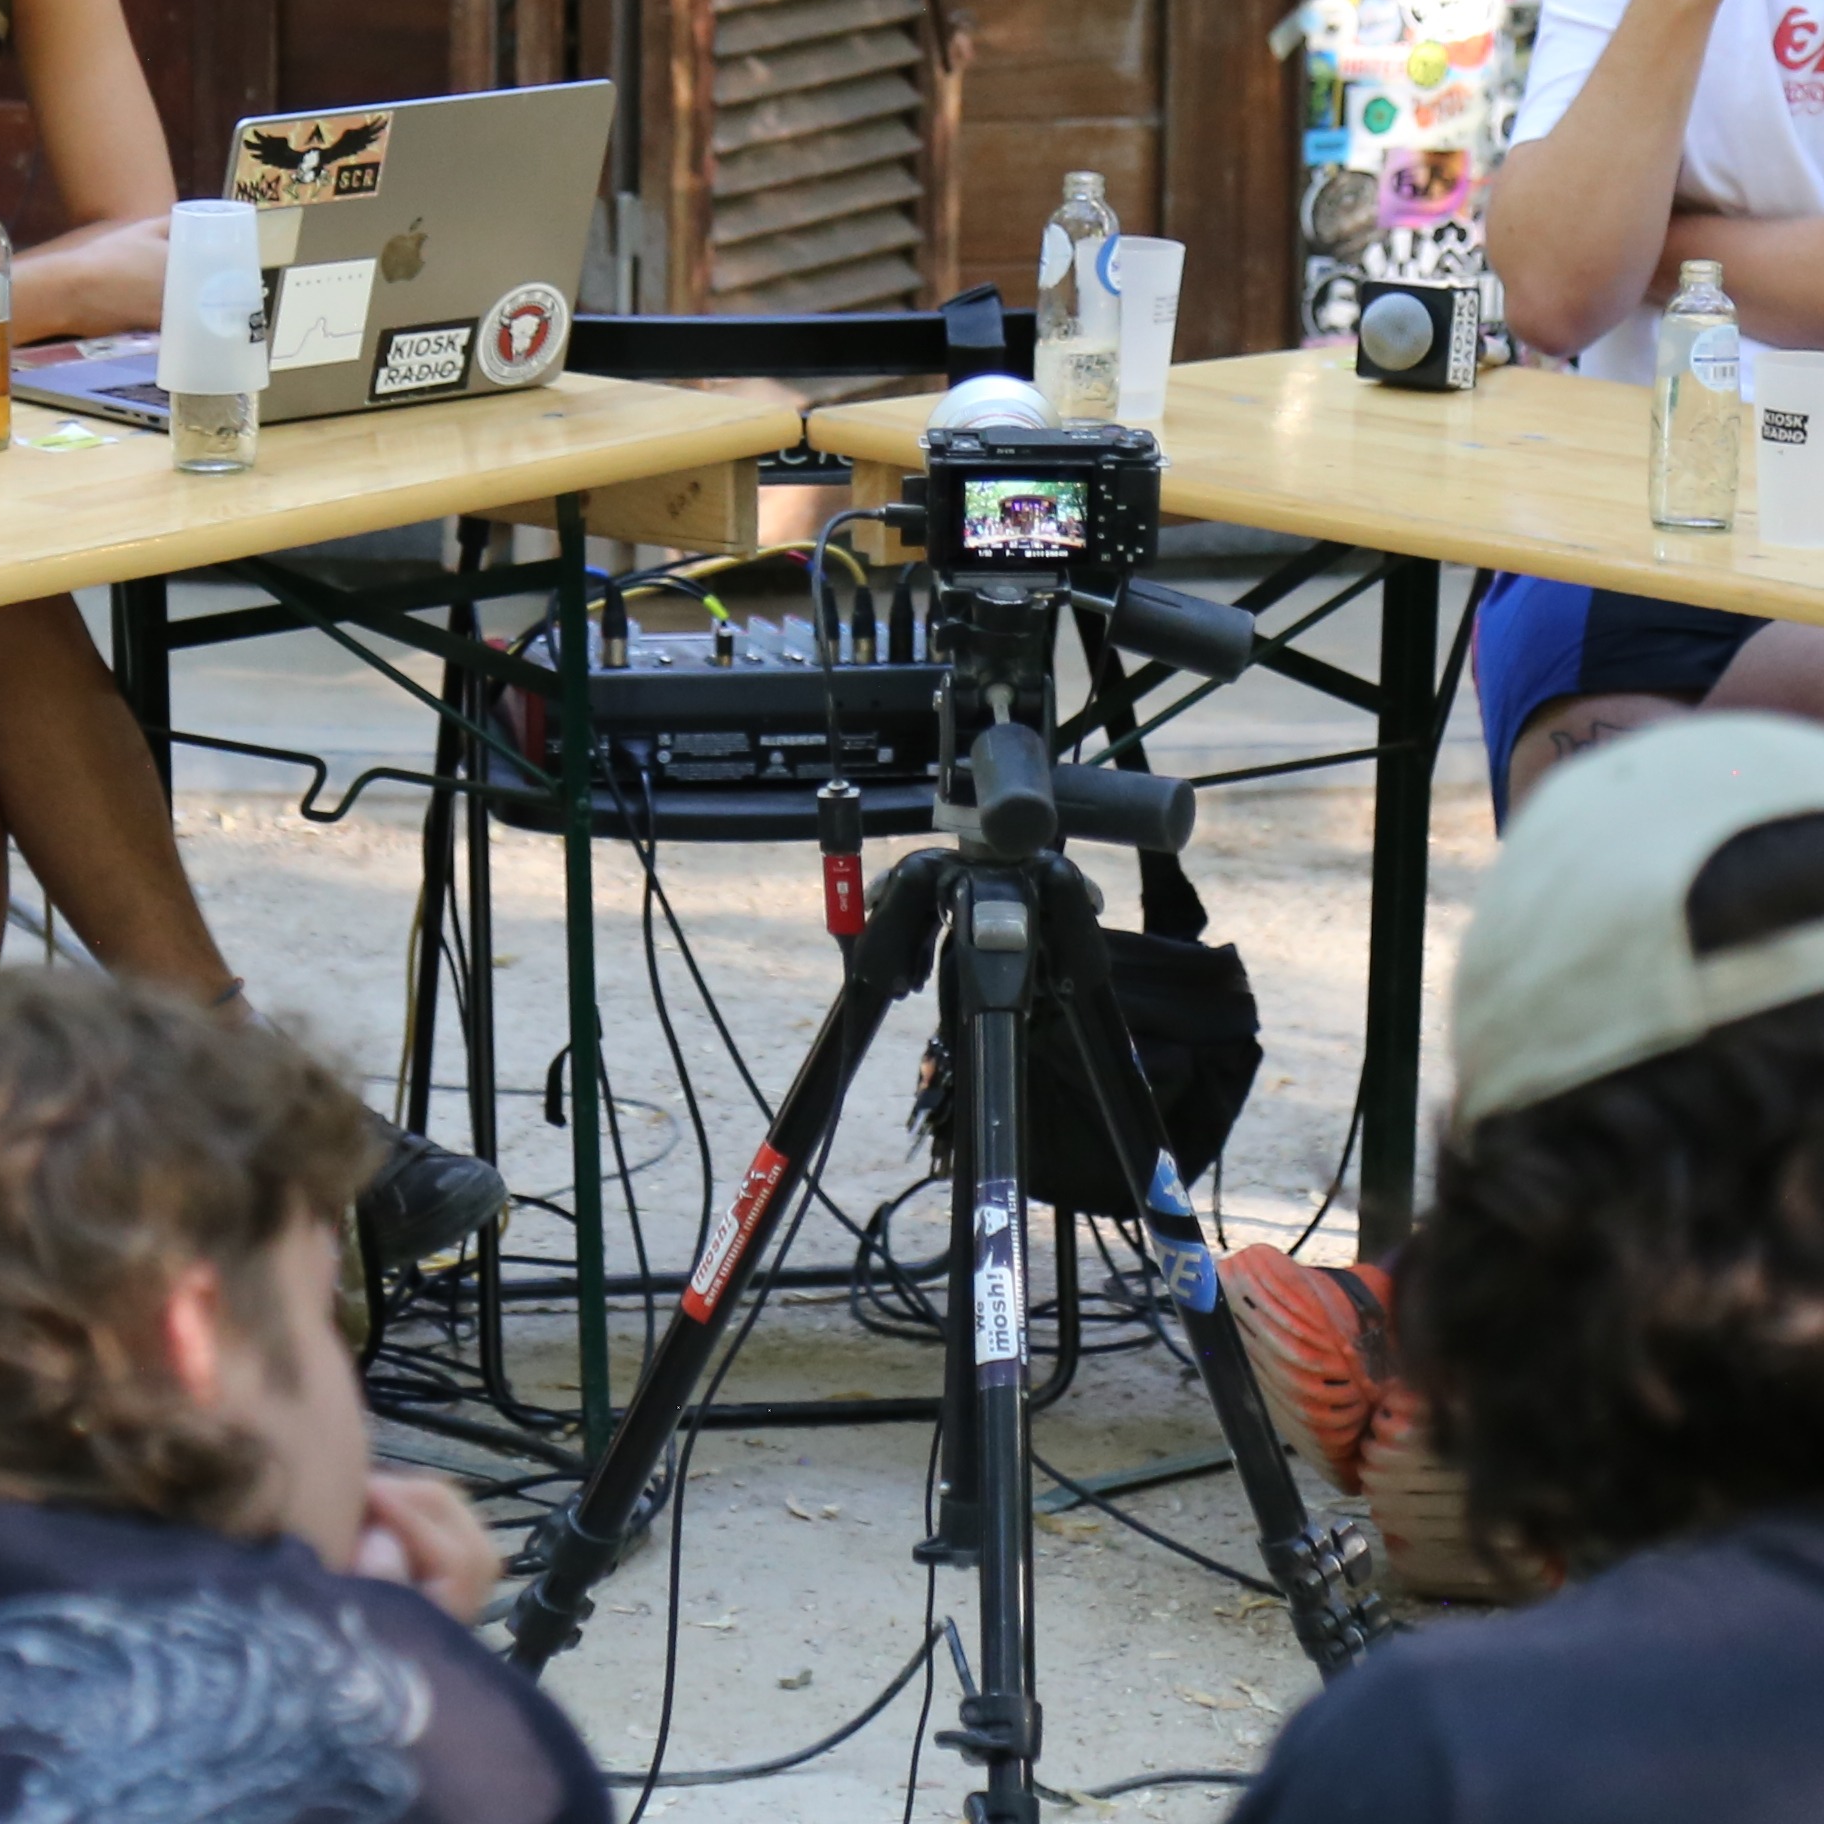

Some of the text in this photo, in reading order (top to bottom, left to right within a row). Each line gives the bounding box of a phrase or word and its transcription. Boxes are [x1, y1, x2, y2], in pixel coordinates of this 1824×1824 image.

[391, 333, 460, 361] KIOSK
[1451, 305, 1465, 382] KIOSK
[1462, 298, 1476, 384] RADIO
[383, 360, 461, 386] RADIO
[1763, 426, 1805, 443] RADIO
[1764, 410, 1804, 428] KIOSK
[695, 1214, 733, 1285] mosh!
[986, 1272, 1011, 1354] mosh!
